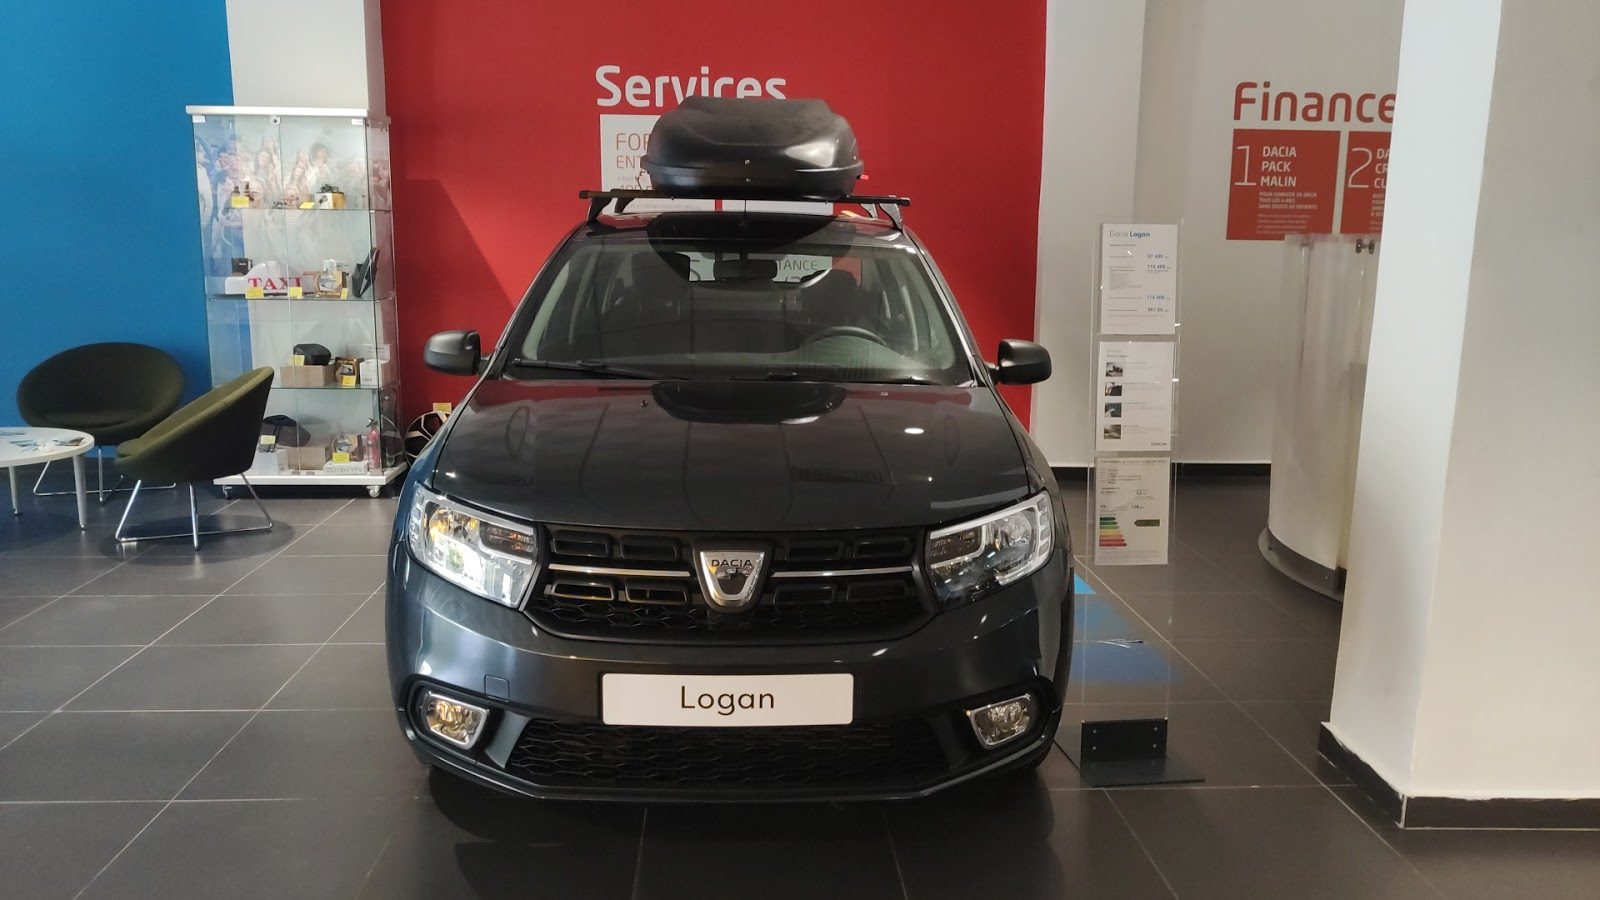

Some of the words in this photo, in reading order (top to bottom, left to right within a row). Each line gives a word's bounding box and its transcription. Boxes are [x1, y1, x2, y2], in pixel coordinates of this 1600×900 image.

[595, 65, 787, 107] Services
[1233, 81, 1396, 123] Finance
[1262, 146, 1297, 158] DACIA
[1261, 161, 1291, 172] PACK
[1348, 147, 1373, 188] 2
[1260, 176, 1297, 187] MALIN
[1129, 231, 1151, 239] Logan
[247, 277, 302, 291] TAXI
[711, 559, 752, 568] DACIA
[680, 685, 776, 716] Logan
